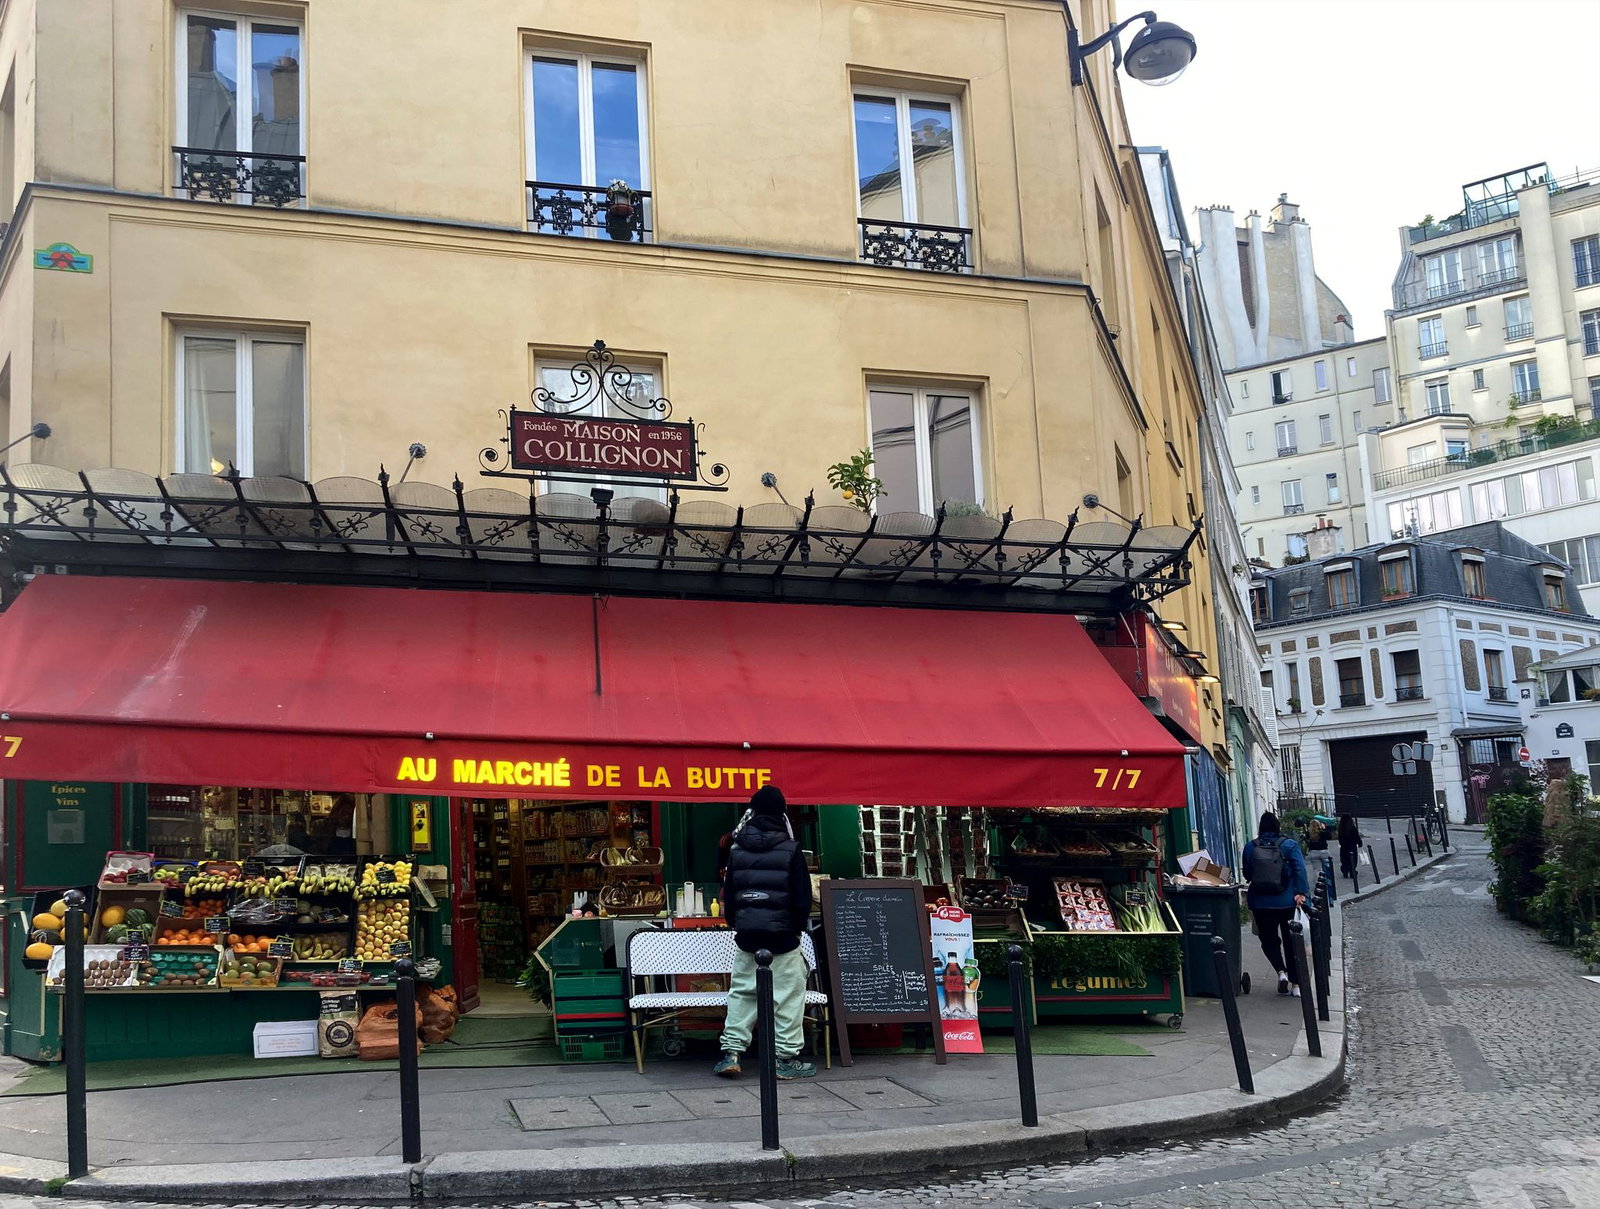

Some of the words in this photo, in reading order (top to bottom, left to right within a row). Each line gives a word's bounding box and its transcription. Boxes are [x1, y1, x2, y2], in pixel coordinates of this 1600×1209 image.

[523, 421, 558, 432] Fondée
[563, 423, 641, 443] MAISON
[648, 432, 660, 440] en
[661, 431, 683, 441] 1956
[524, 438, 683, 469] COLLIGNON
[396, 756, 437, 783] AU
[453, 757, 571, 787] MARCHÉ
[586, 764, 622, 787] DE
[637, 765, 672, 788] LA
[687, 766, 772, 790] BUTTE
[1093, 768, 1142, 790] 7/7
[56, 797, 80, 806] Vins
